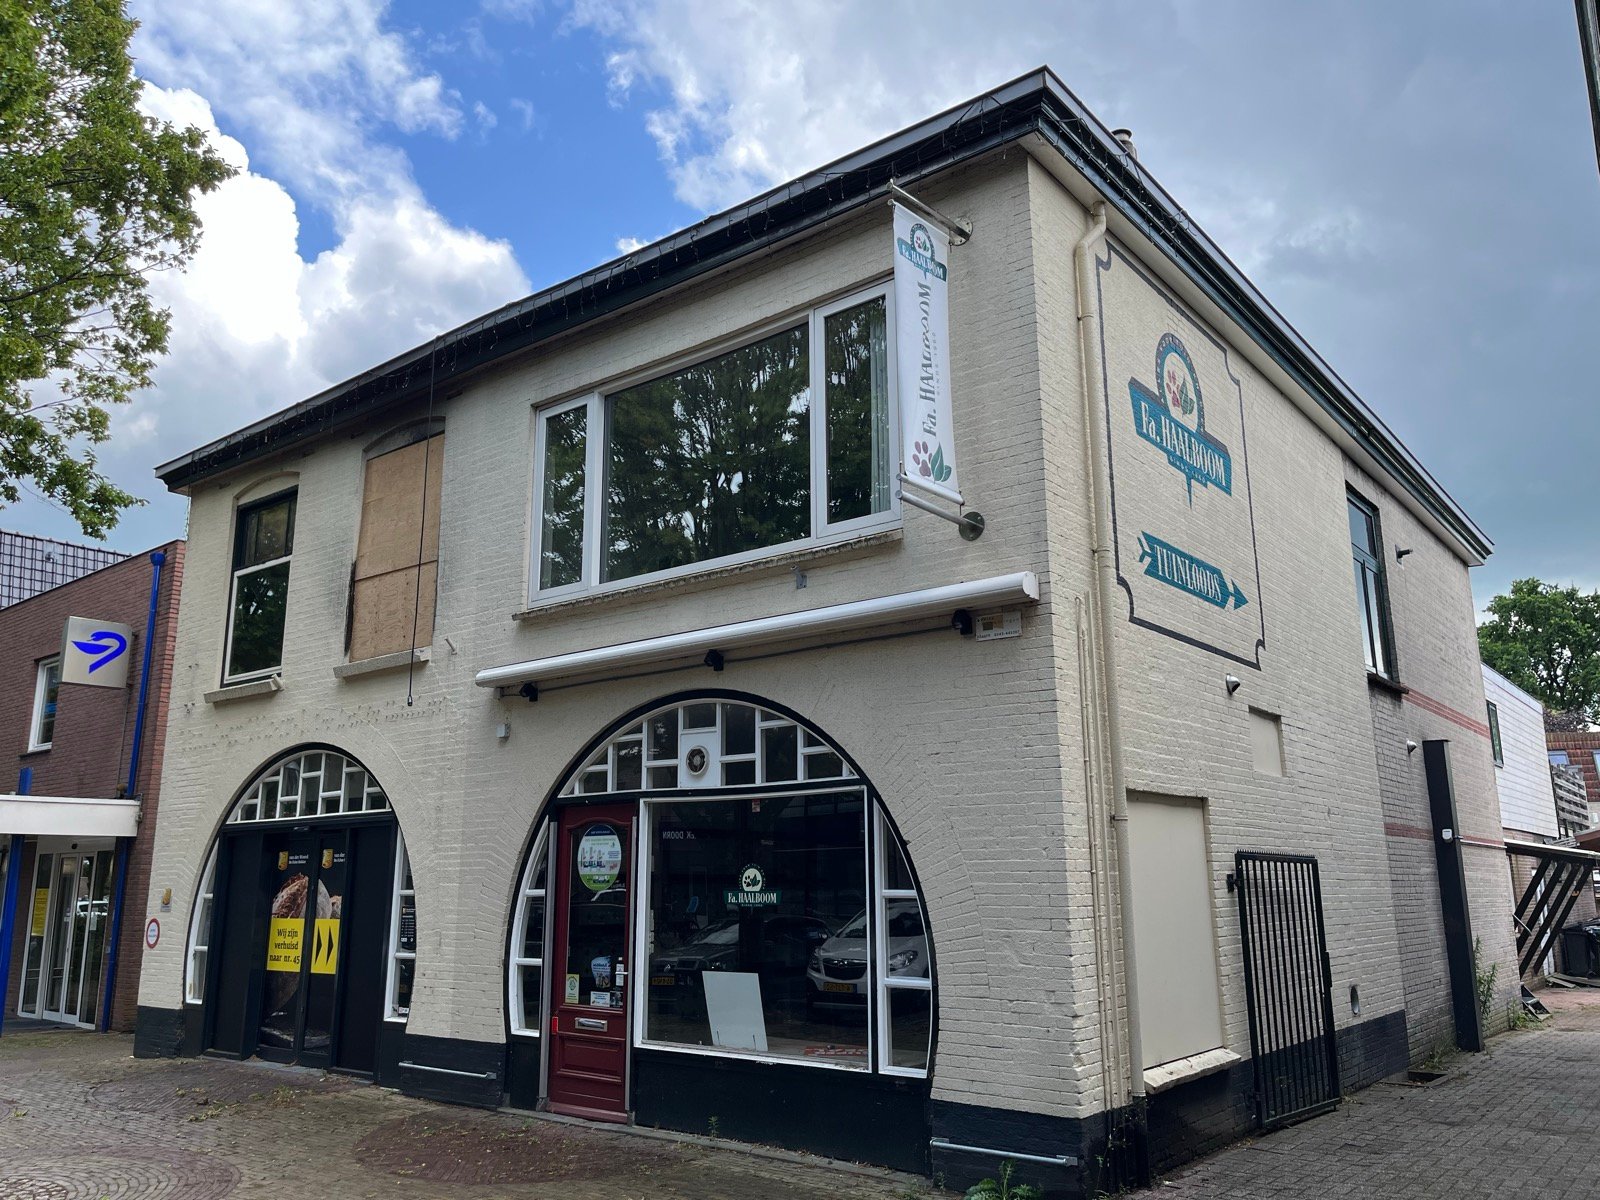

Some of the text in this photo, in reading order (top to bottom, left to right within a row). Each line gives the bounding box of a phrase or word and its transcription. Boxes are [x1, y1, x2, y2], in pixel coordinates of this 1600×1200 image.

[922, 409, 937, 437] Fa.
[1141, 400, 1160, 442] Fa.
[1161, 414, 1226, 486] HAALBOOM
[1154, 544, 1222, 602] TUINLOODS
[728, 892, 777, 904] Fa. HAALBOOM
[277, 928, 299, 939] Wij zijn
[274, 941, 299, 950] verhuisd
[293, 956, 300, 965] 45
